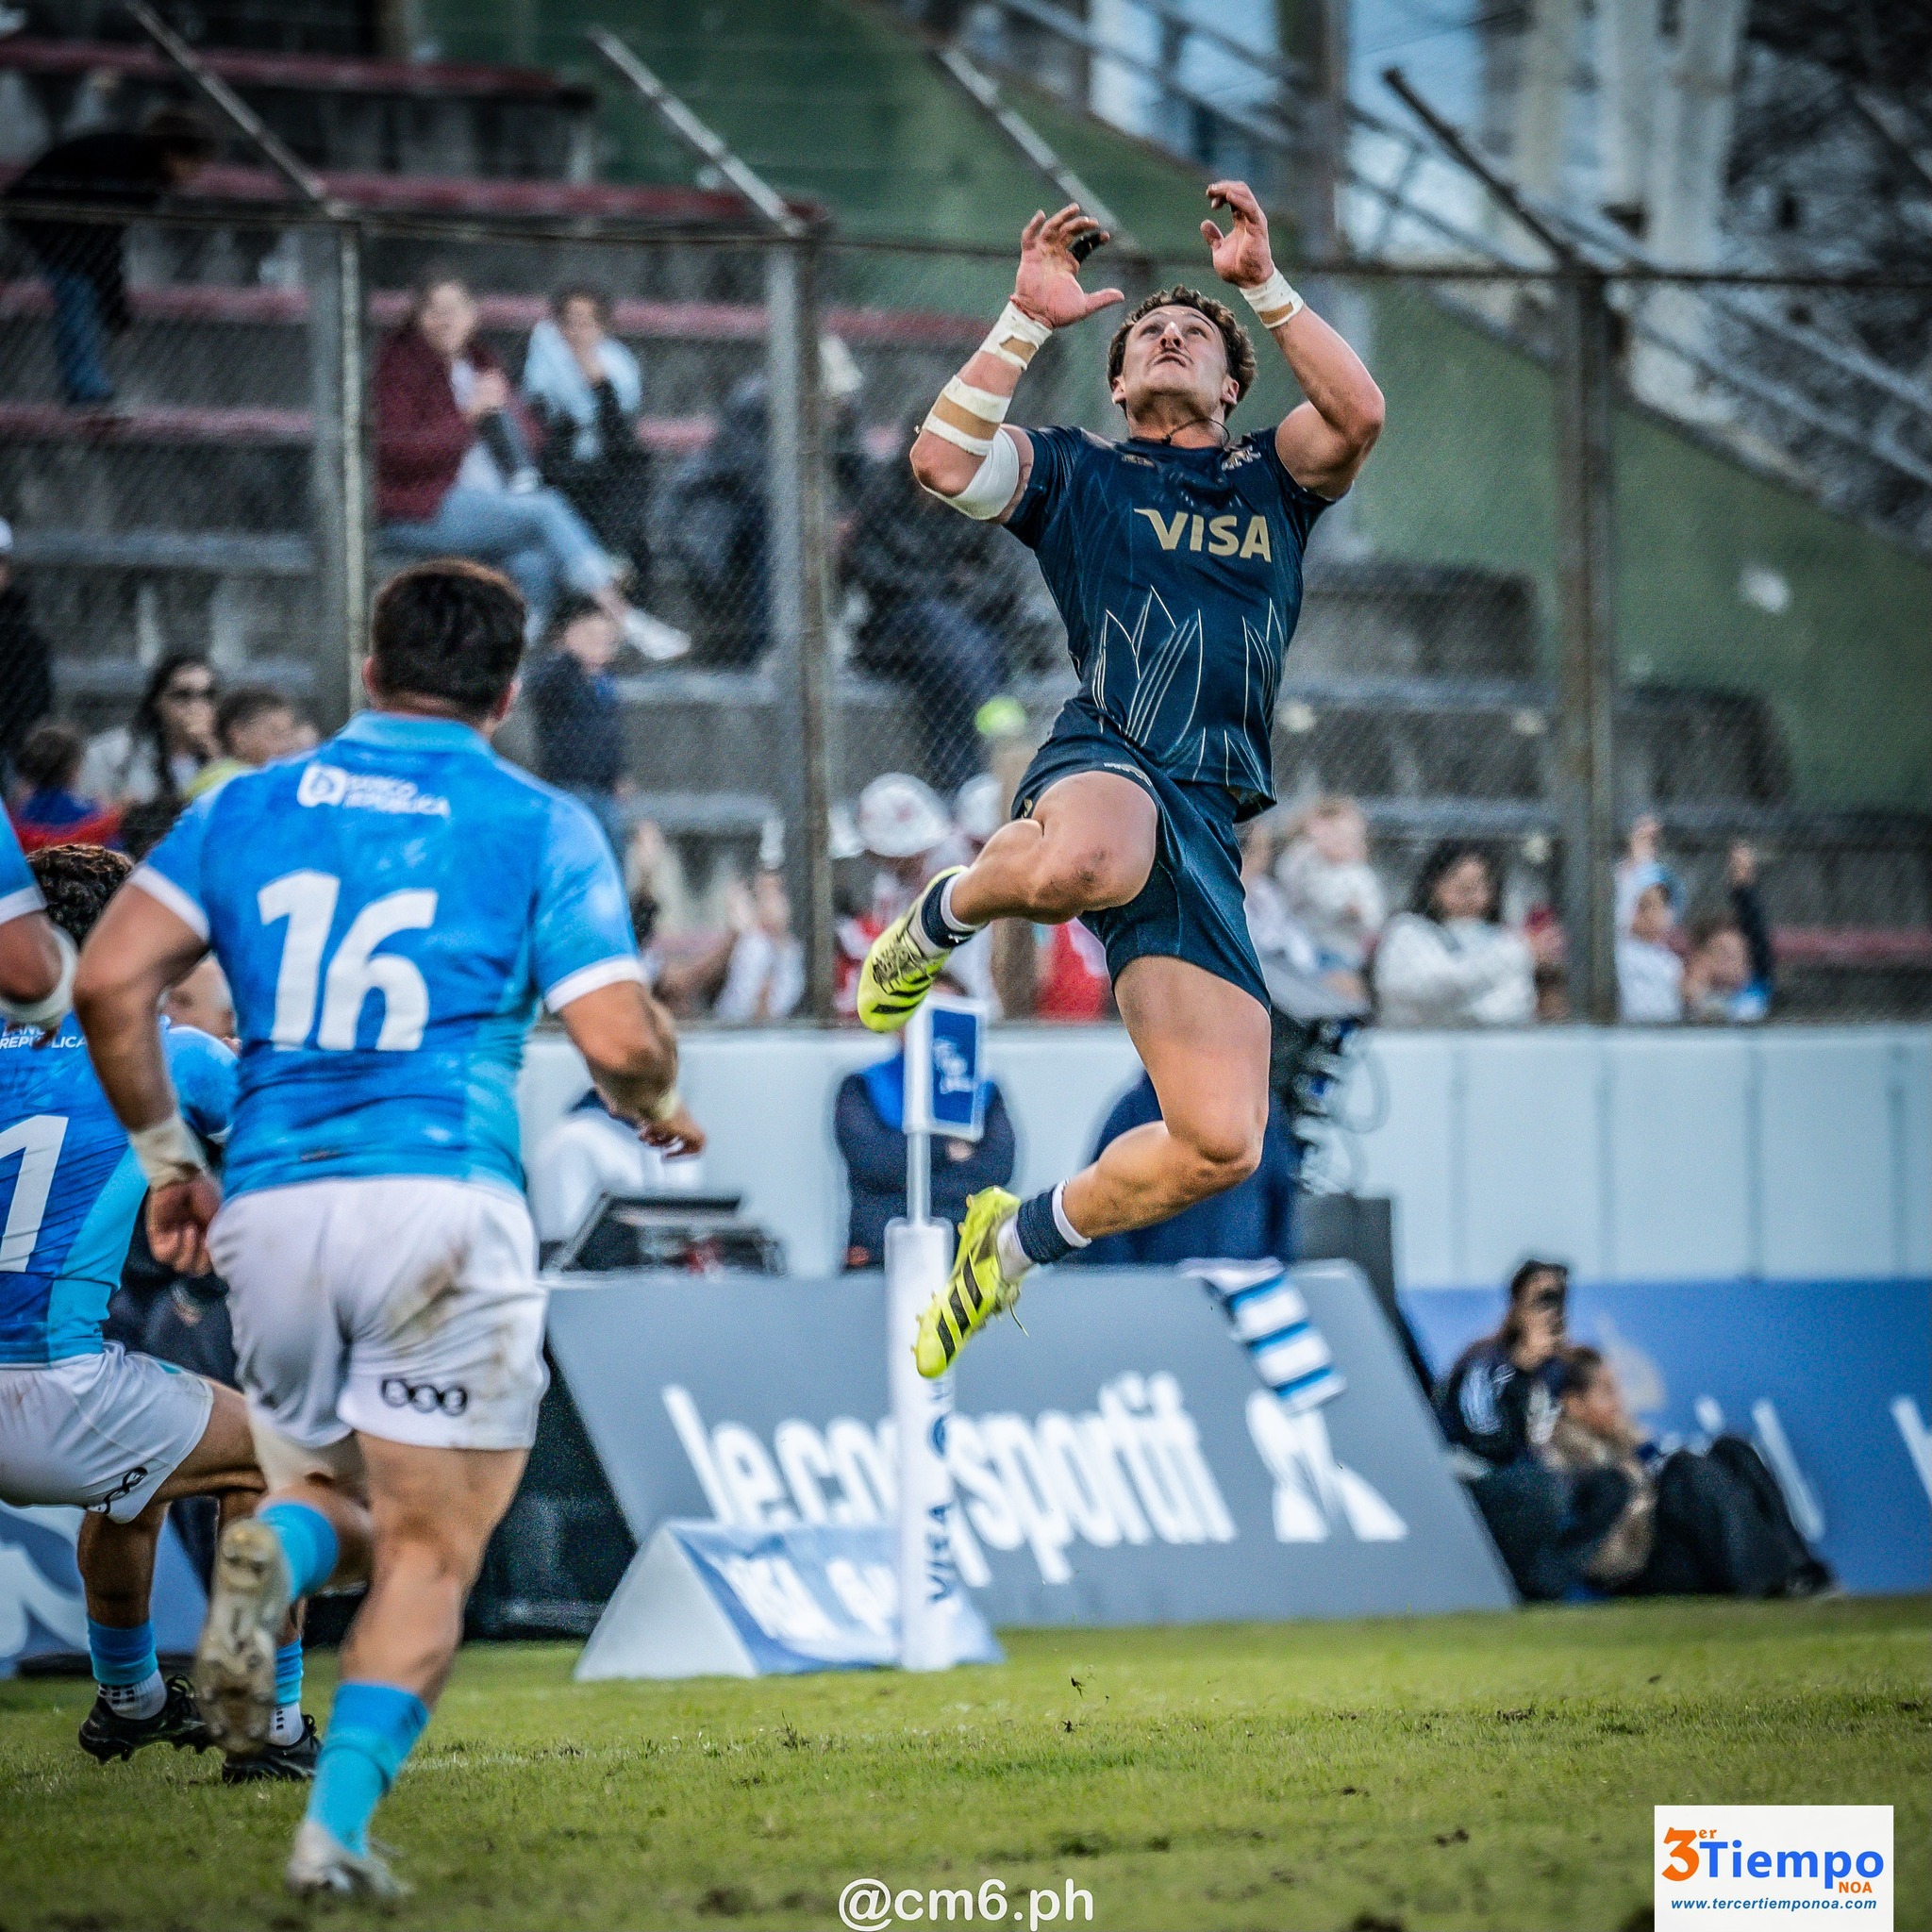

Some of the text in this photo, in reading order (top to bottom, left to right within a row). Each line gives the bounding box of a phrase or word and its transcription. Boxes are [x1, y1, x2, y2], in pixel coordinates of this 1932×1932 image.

[1134, 508, 1272, 563] VISA
[257, 871, 438, 1052] 16
[0, 1115, 69, 1273] 1
